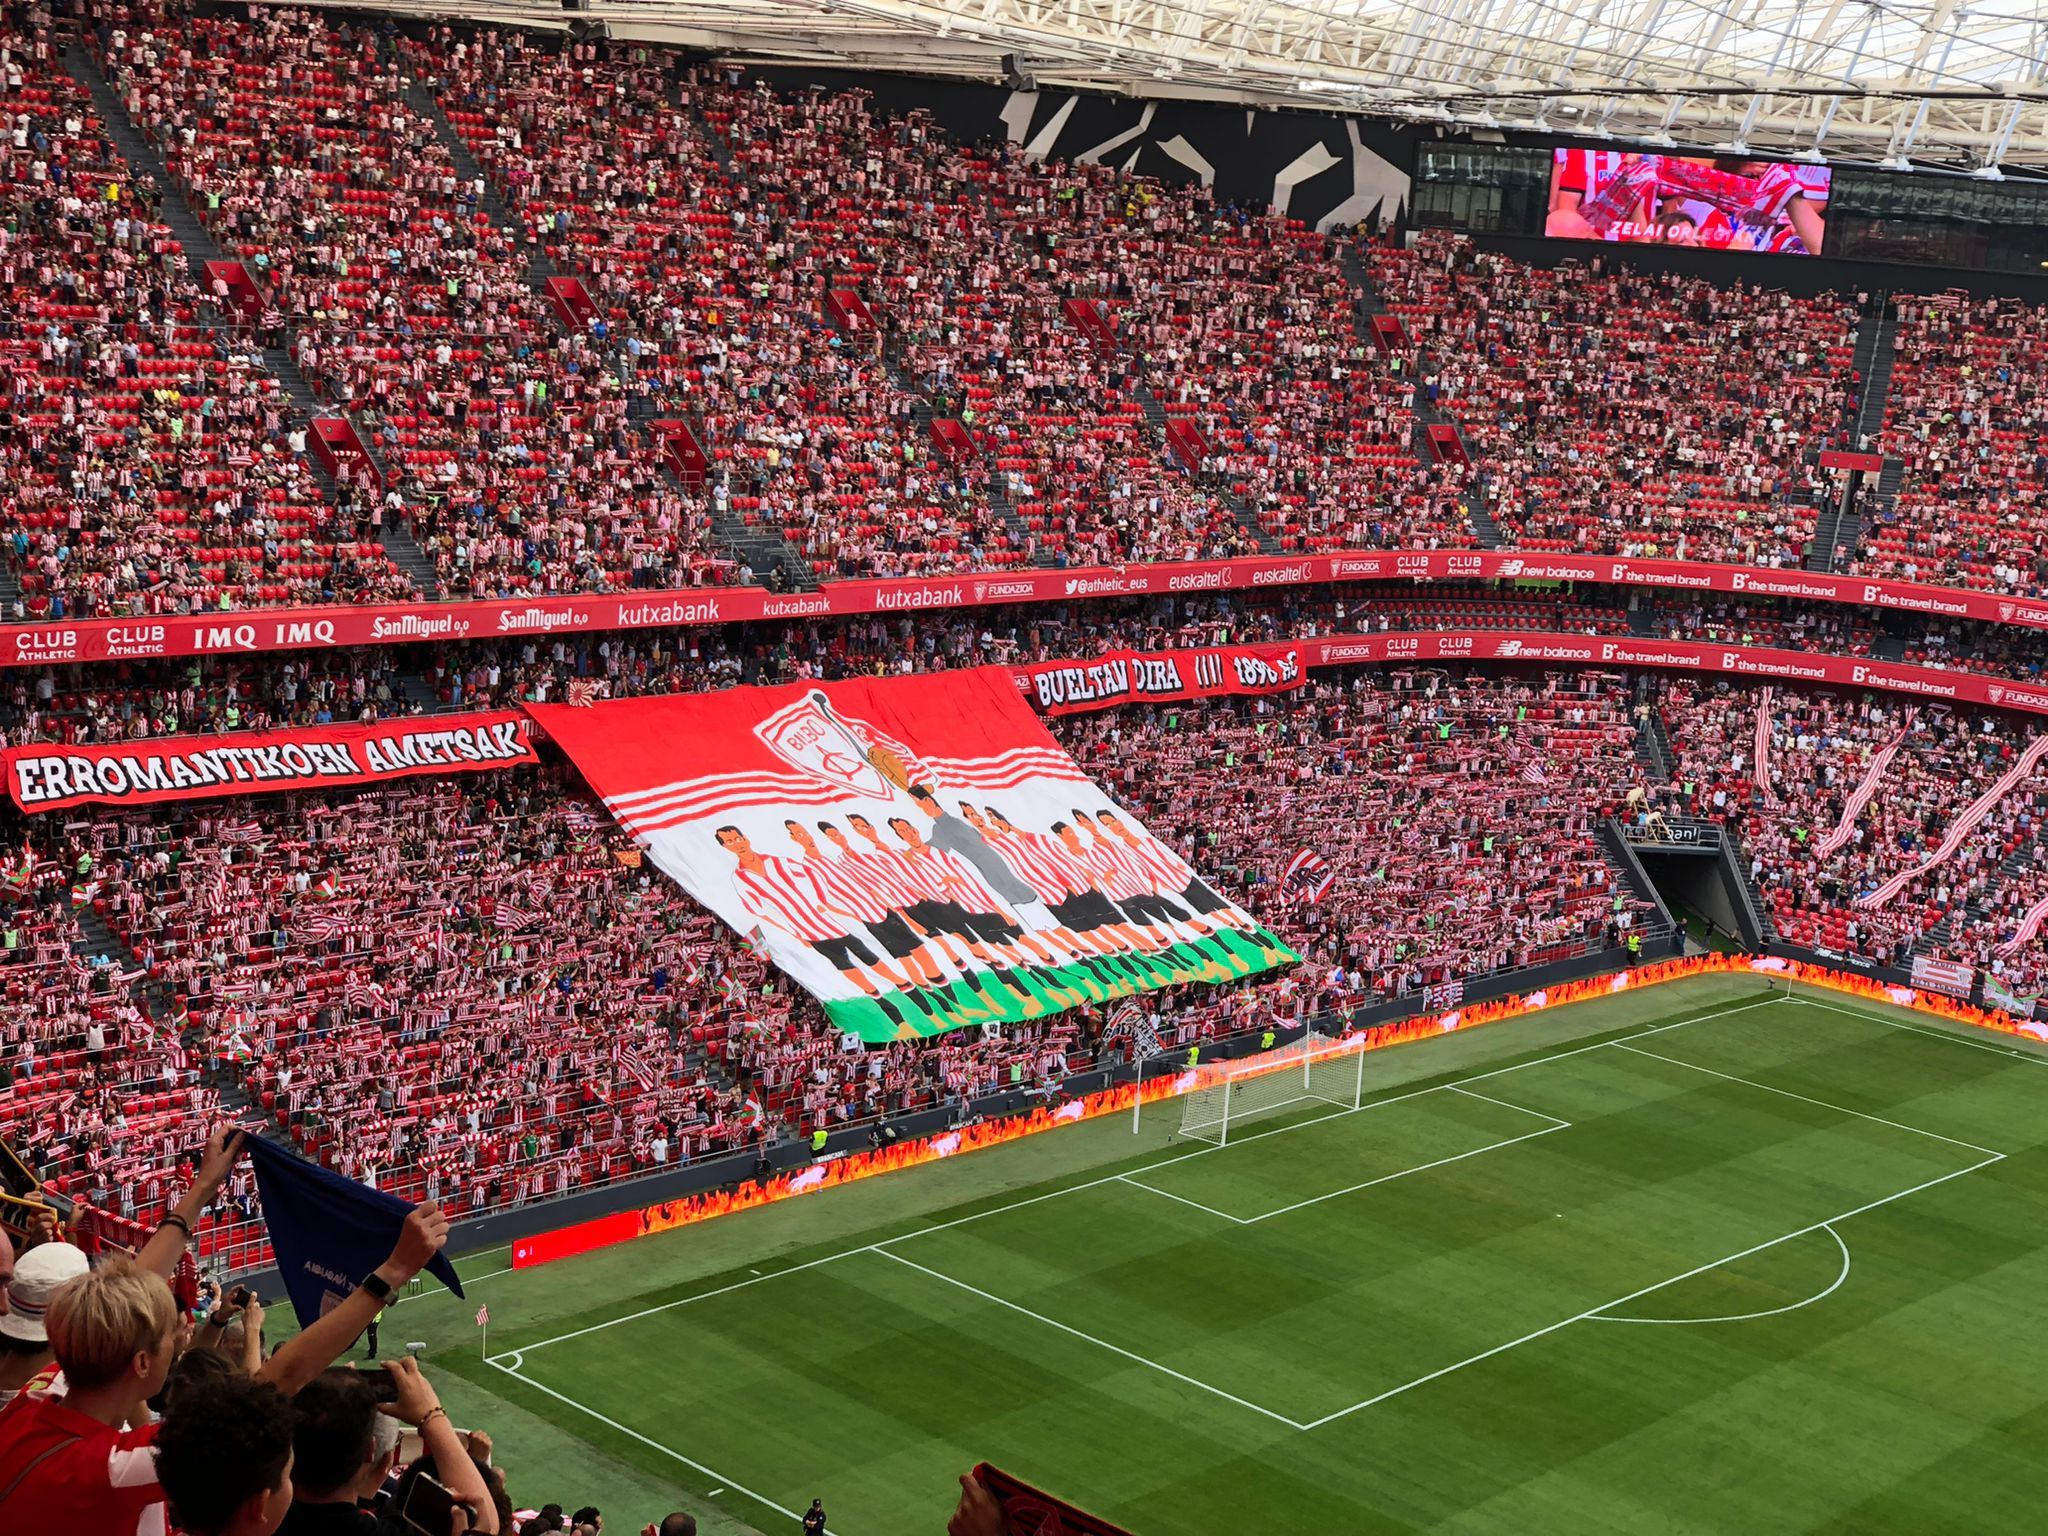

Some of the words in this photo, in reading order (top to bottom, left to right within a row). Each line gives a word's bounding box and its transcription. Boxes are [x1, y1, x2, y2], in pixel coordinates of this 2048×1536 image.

[1609, 221, 1664, 238] ZELAI
[1397, 555, 1429, 567] CLUB
[1448, 555, 1482, 567] CLUB
[1168, 570, 1221, 590] euskaltel
[1252, 565, 1301, 585] euskaltel
[1447, 568, 1481, 576] ATHLETIC
[1523, 567, 1544, 577] new
[1547, 565, 1595, 579] balance
[1626, 570, 1644, 582] the
[1646, 572, 1677, 584] travel
[1678, 574, 1711, 587] brand
[1078, 576, 1148, 594] @athletic_eus
[1748, 580, 1767, 591] the
[1769, 583, 1800, 594] travel
[1802, 585, 1836, 597] brand
[875, 584, 963, 609] kutxabank
[1880, 594, 1898, 605] the
[1899, 597, 1932, 609] travel
[1933, 600, 1968, 613] brand
[618, 598, 720, 625] kutxabank
[762, 597, 831, 616] kutxabank
[16, 630, 77, 650] CLUB
[106, 625, 165, 645] CLUB
[194, 625, 257, 649] IMQ
[275, 620, 336, 644] IMQ
[106, 643, 164, 656] ATHLETIC
[1386, 638, 1419, 650] CLUB
[1439, 637, 1473, 649] CLUB
[1519, 647, 1541, 657] new
[1543, 645, 1592, 659] balance
[16, 649, 76, 662] ATHLETIC
[1616, 650, 1634, 661] the
[1636, 652, 1667, 663] travel
[1668, 653, 1700, 665] brand
[1738, 660, 1757, 671] the
[1758, 663, 1790, 674] travel
[1791, 665, 1825, 678] brand
[1035, 659, 1130, 707] BUELTAN
[1131, 658, 1182, 690] DIRA
[1868, 674, 1887, 686] the
[1888, 677, 1920, 690] travel
[1921, 681, 1955, 696] brand
[786, 718, 826, 752] BILBO
[15, 742, 363, 803] ERROMANTIKOEN
[364, 721, 528, 773] AMETSAK
